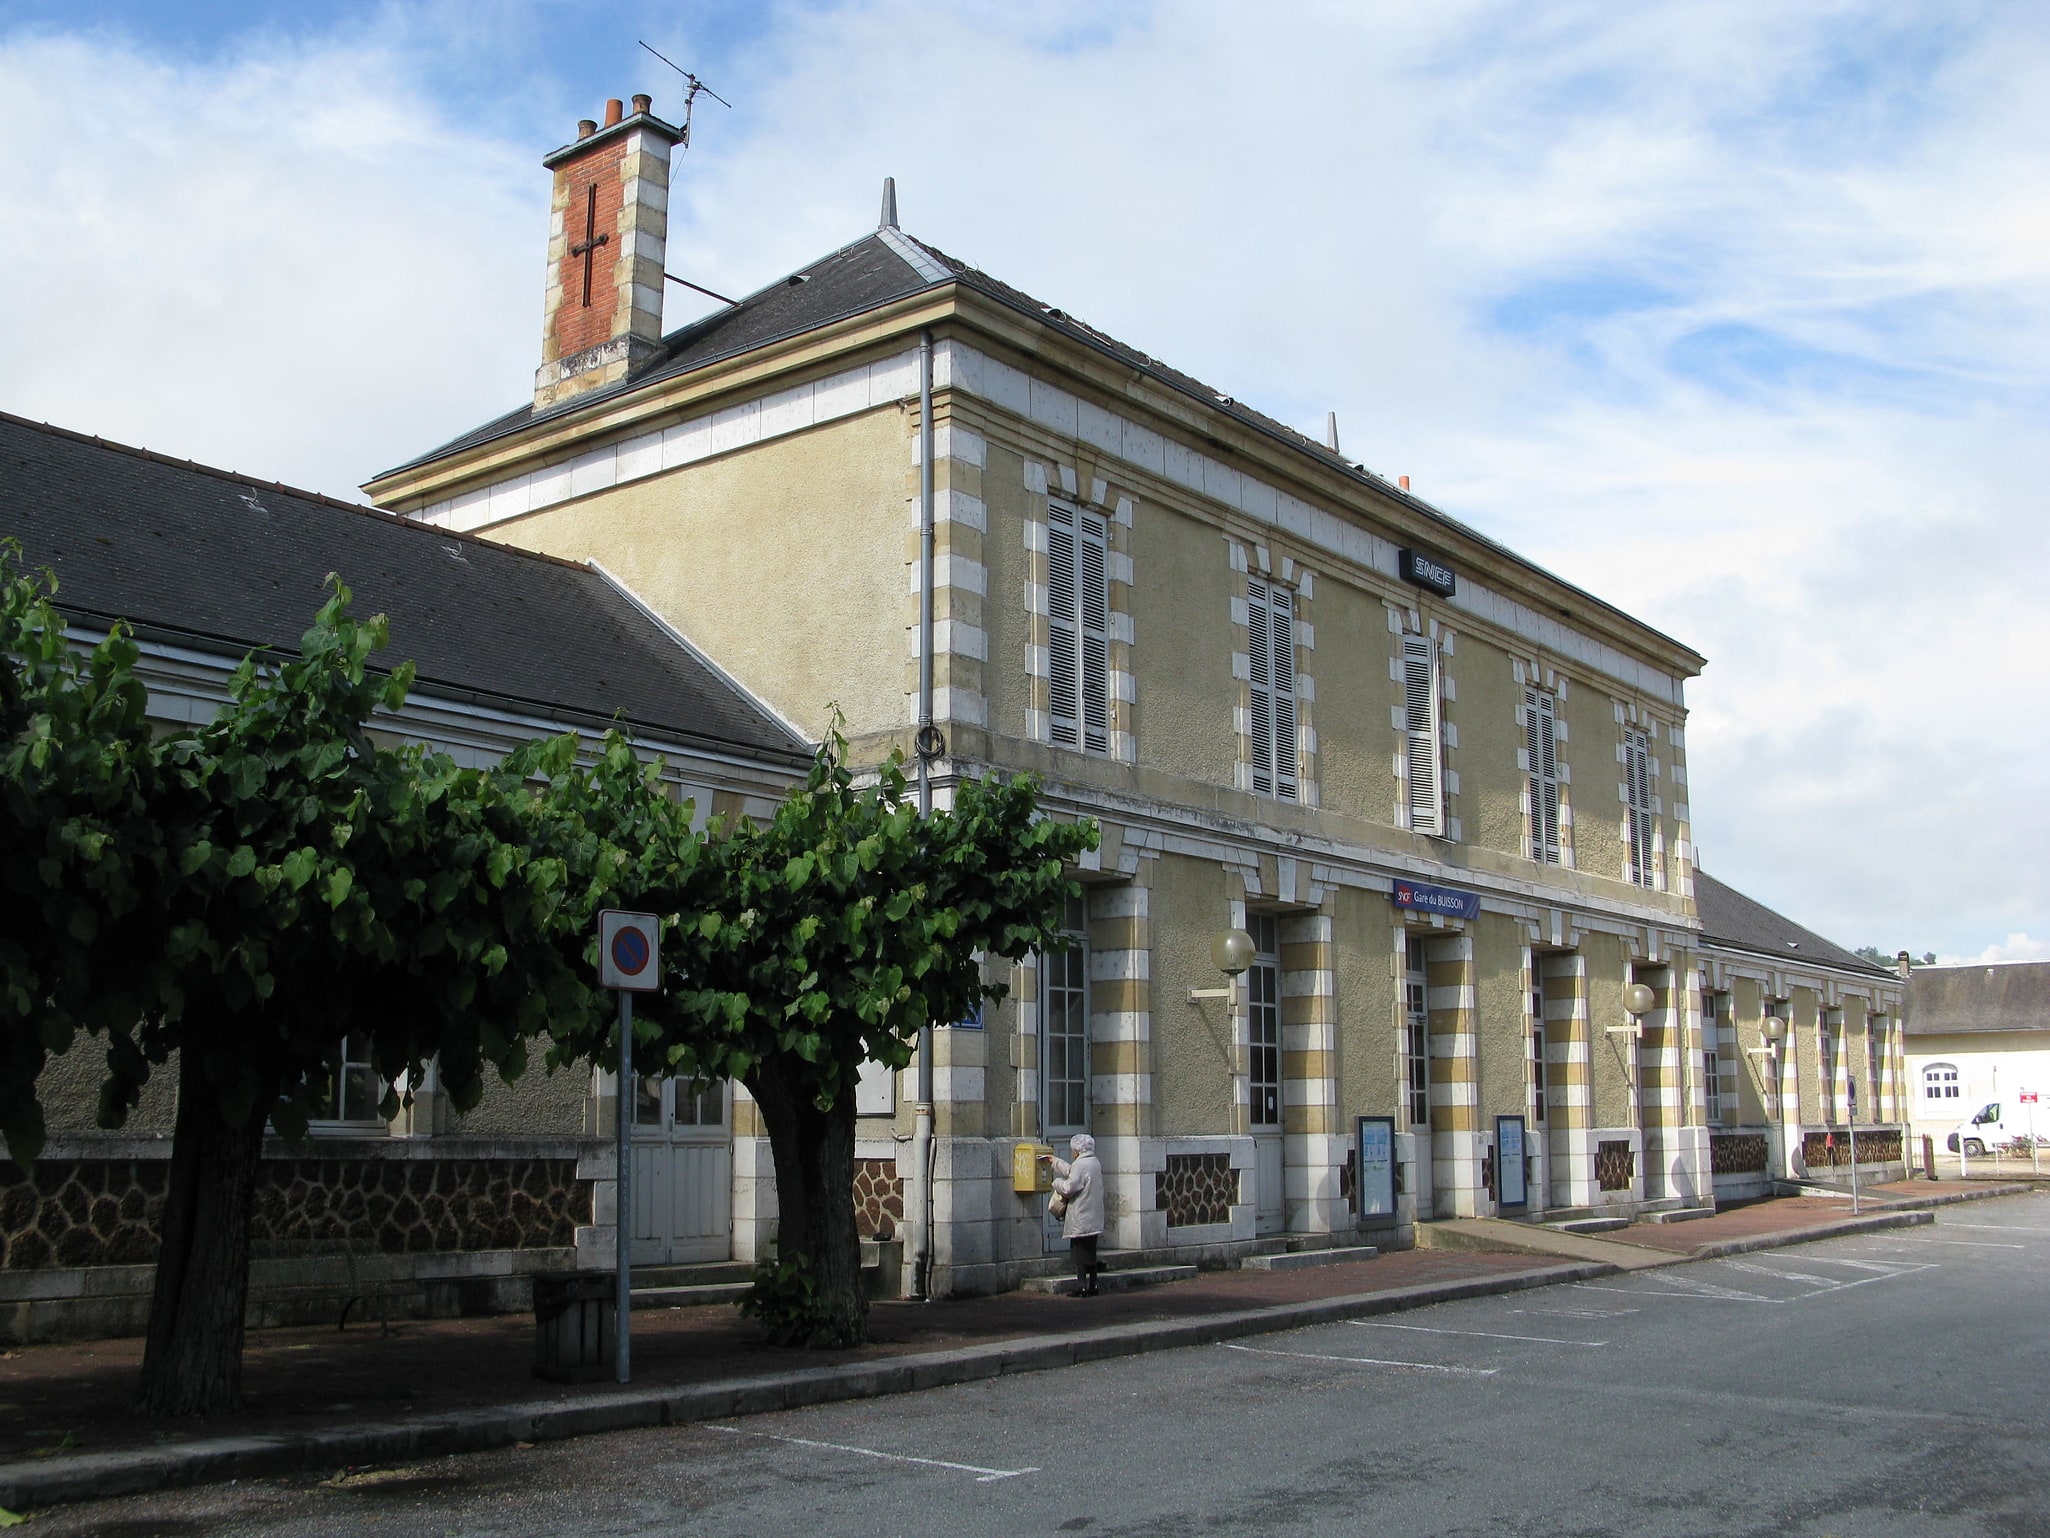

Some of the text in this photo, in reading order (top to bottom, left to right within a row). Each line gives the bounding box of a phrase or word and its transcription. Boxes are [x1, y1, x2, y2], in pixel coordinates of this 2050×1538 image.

[1415, 557, 1451, 586] SNCF
[1398, 891, 1411, 902] SNCF
[1413, 891, 1464, 910] Gare du BUISSON
